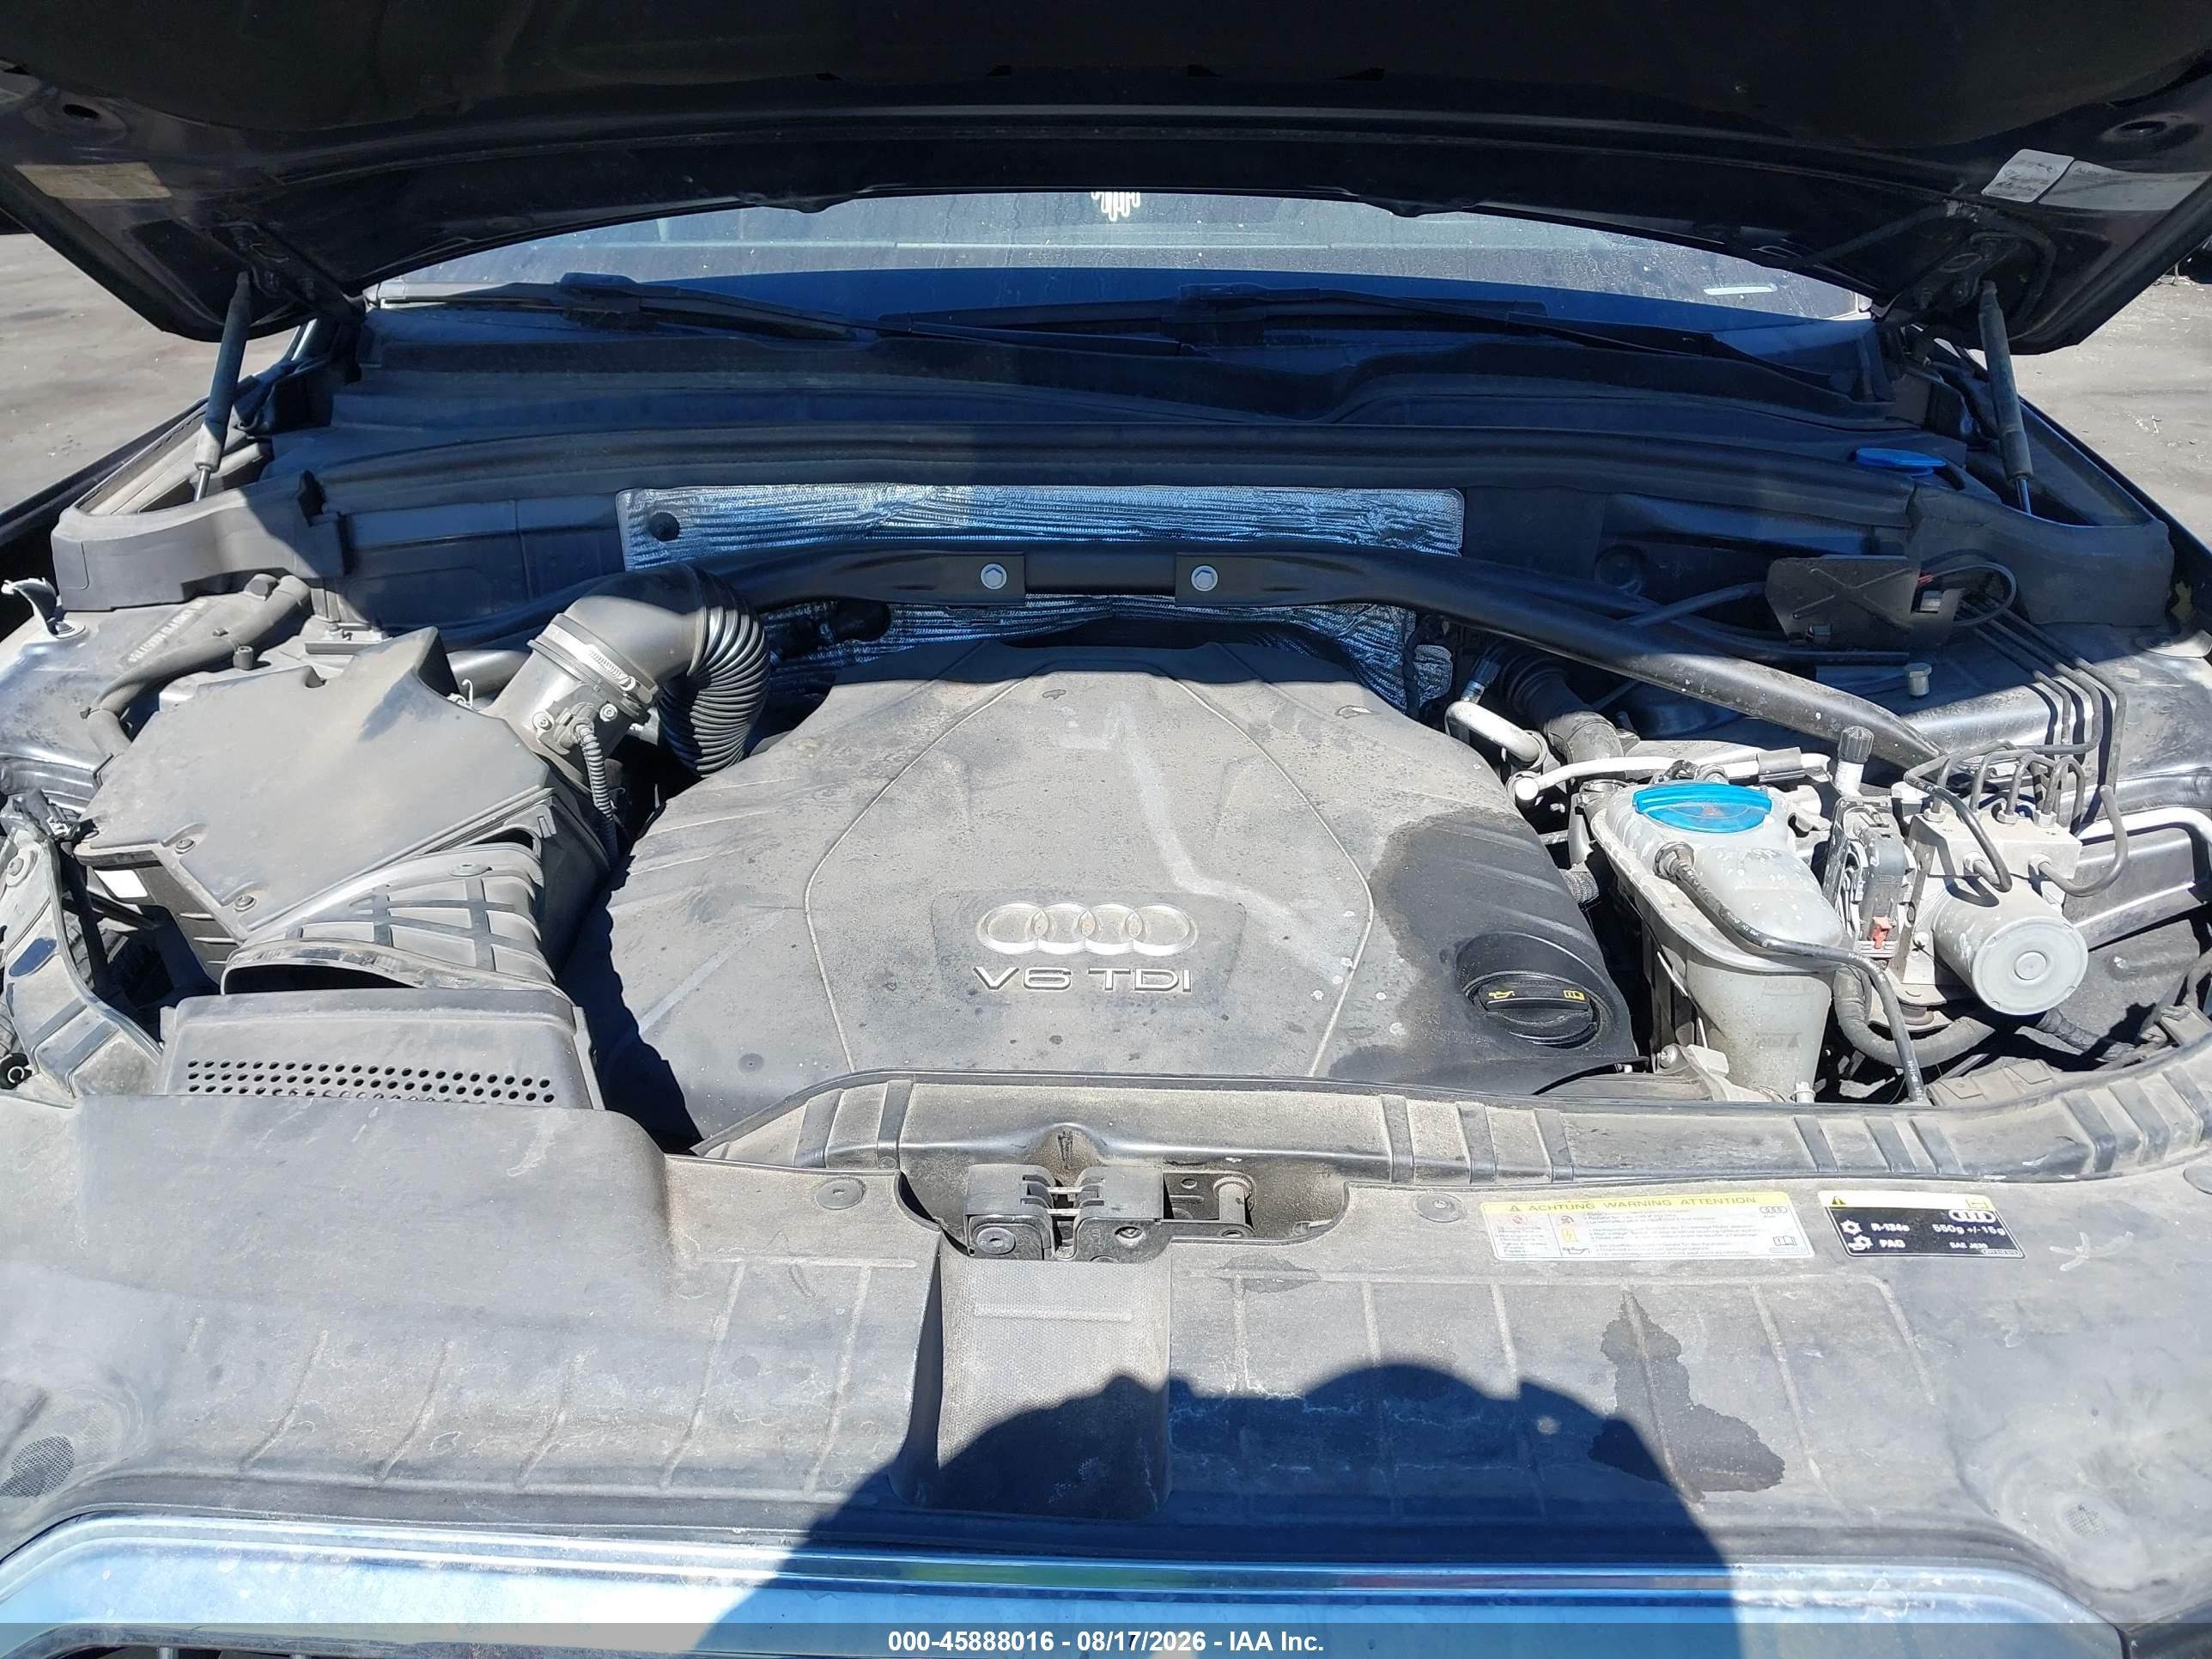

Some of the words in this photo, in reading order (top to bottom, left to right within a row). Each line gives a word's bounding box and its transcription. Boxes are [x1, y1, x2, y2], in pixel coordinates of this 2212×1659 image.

[973, 966, 1073, 991] V6
[1086, 967, 1192, 993] TDI
[1528, 1201, 1595, 1212] ACHTUNG
[1603, 1200, 1672, 1208] WARNING
[1680, 1196, 1757, 1205] ATTENTION
[1932, 1224, 1965, 1235] 550g
